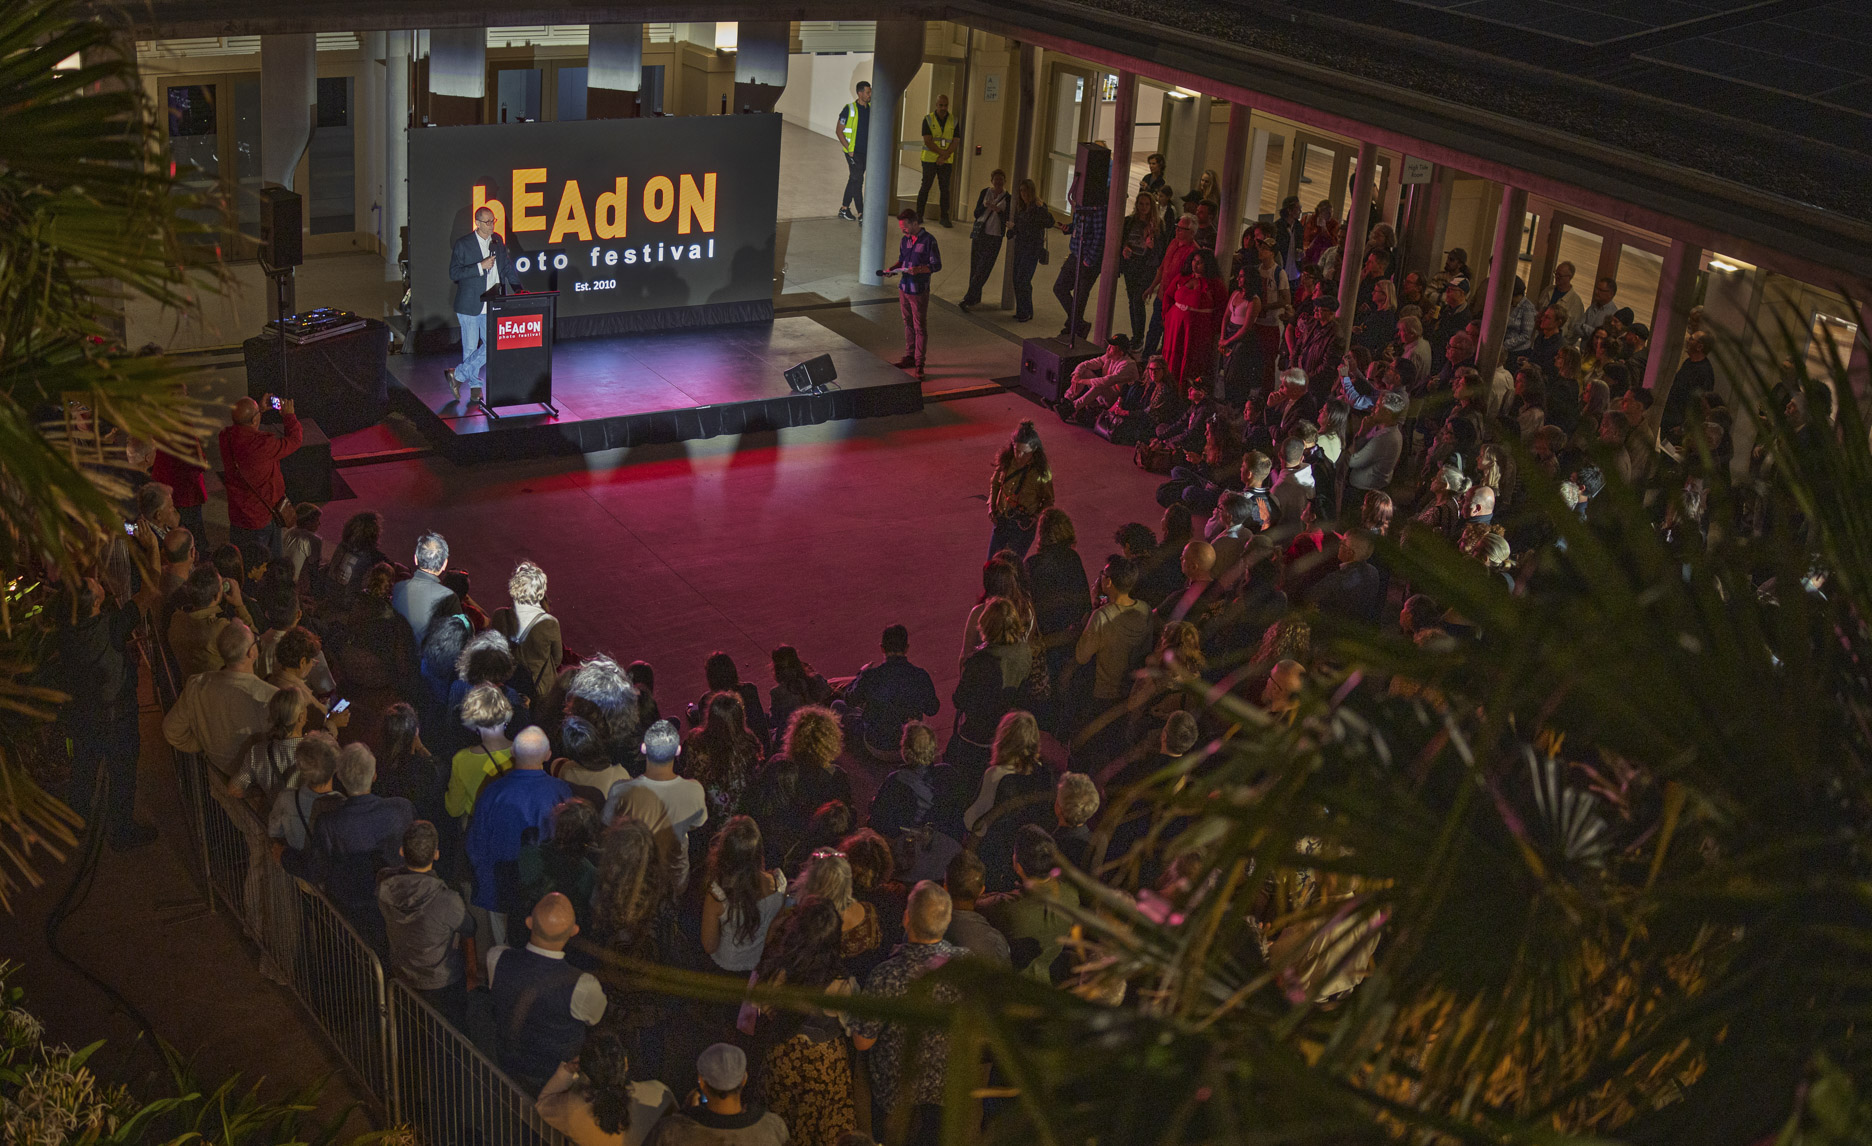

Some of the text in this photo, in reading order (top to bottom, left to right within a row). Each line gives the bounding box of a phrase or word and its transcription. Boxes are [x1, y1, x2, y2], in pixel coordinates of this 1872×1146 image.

[516, 239, 714, 272] oto festival
[575, 279, 617, 291] Est. 2010
